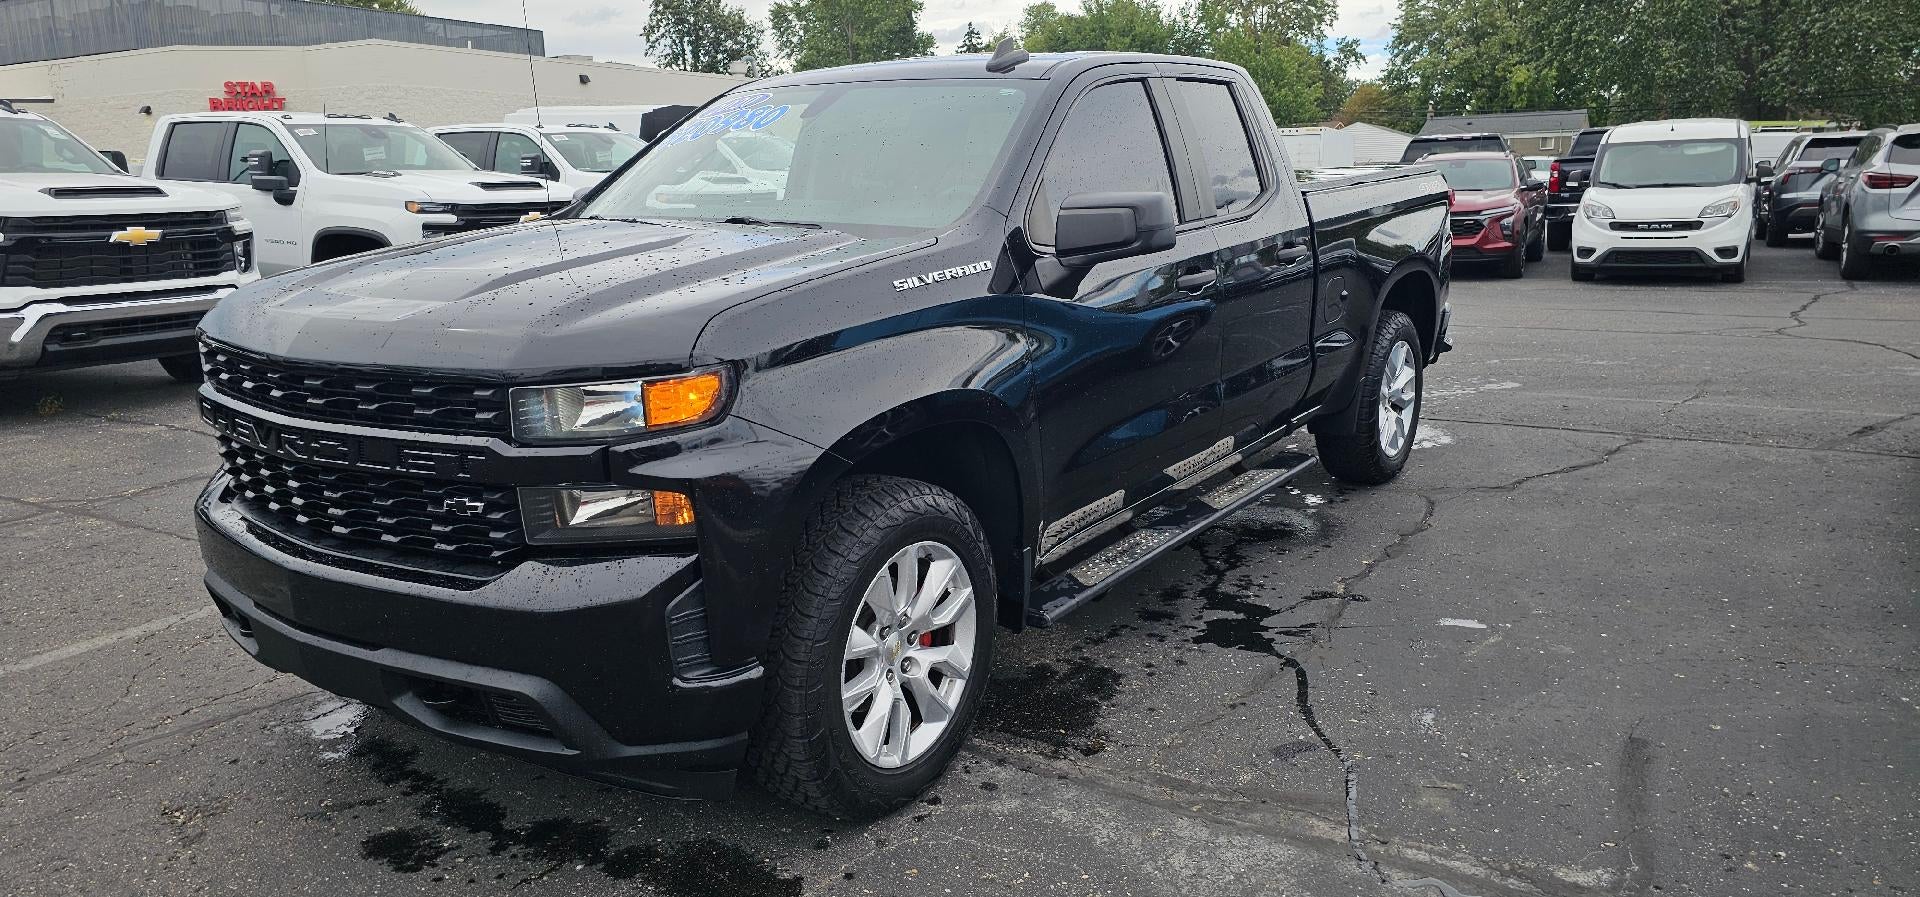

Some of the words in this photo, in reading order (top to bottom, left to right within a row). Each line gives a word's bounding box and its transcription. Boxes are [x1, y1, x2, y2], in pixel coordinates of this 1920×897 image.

[223, 81, 276, 97] STAR
[208, 97, 286, 111] BRIGHT
[892, 260, 993, 292] SILVERADO
[200, 401, 487, 478] CHEVROLET
